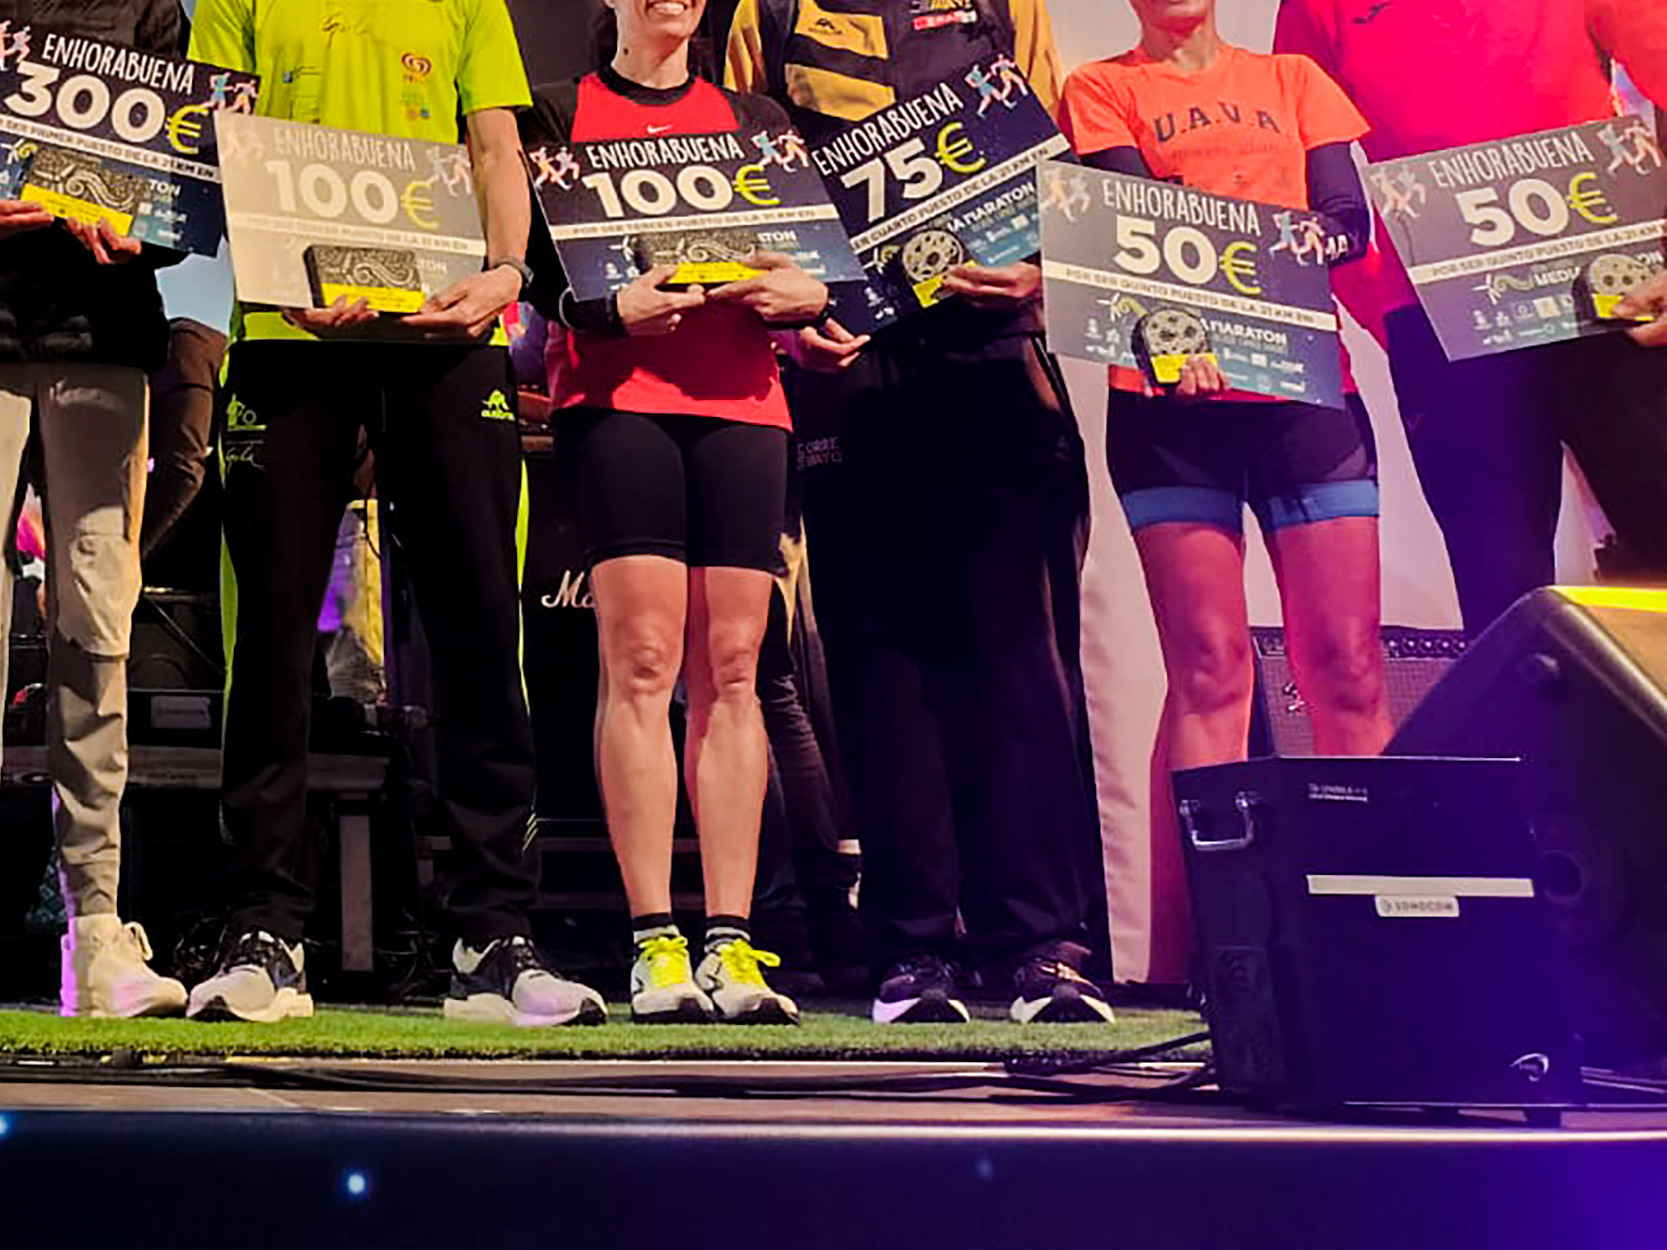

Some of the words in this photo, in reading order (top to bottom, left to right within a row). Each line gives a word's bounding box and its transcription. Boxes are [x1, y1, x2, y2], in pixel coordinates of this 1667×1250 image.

[42, 33, 195, 95] ENHORABUENA
[3, 60, 210, 155] 300€
[811, 82, 964, 177] ENHORABUENA
[196, 166, 215, 178] EN
[274, 124, 417, 171] ENHORABUENA
[587, 133, 745, 169] ENHORABUENA
[841, 121, 987, 224] 75€
[1430, 131, 1594, 189] ENHORABUENA
[265, 160, 441, 230] 100€
[581, 163, 781, 218] 100€
[868, 212, 918, 241] CUARTO
[915, 189, 963, 218] PUESTO
[962, 181, 980, 195] DE
[979, 172, 997, 186] LA
[963, 182, 1035, 225] MARATON
[1102, 178, 1262, 237] ENHORABUENA
[1455, 171, 1619, 247] 50€
[1114, 215, 1263, 295] 50€
[1534, 239, 1584, 257] PUESTO
[1604, 232, 1622, 244] LA
[1209, 319, 1287, 346] MARATON
[1240, 301, 1257, 312] LA
